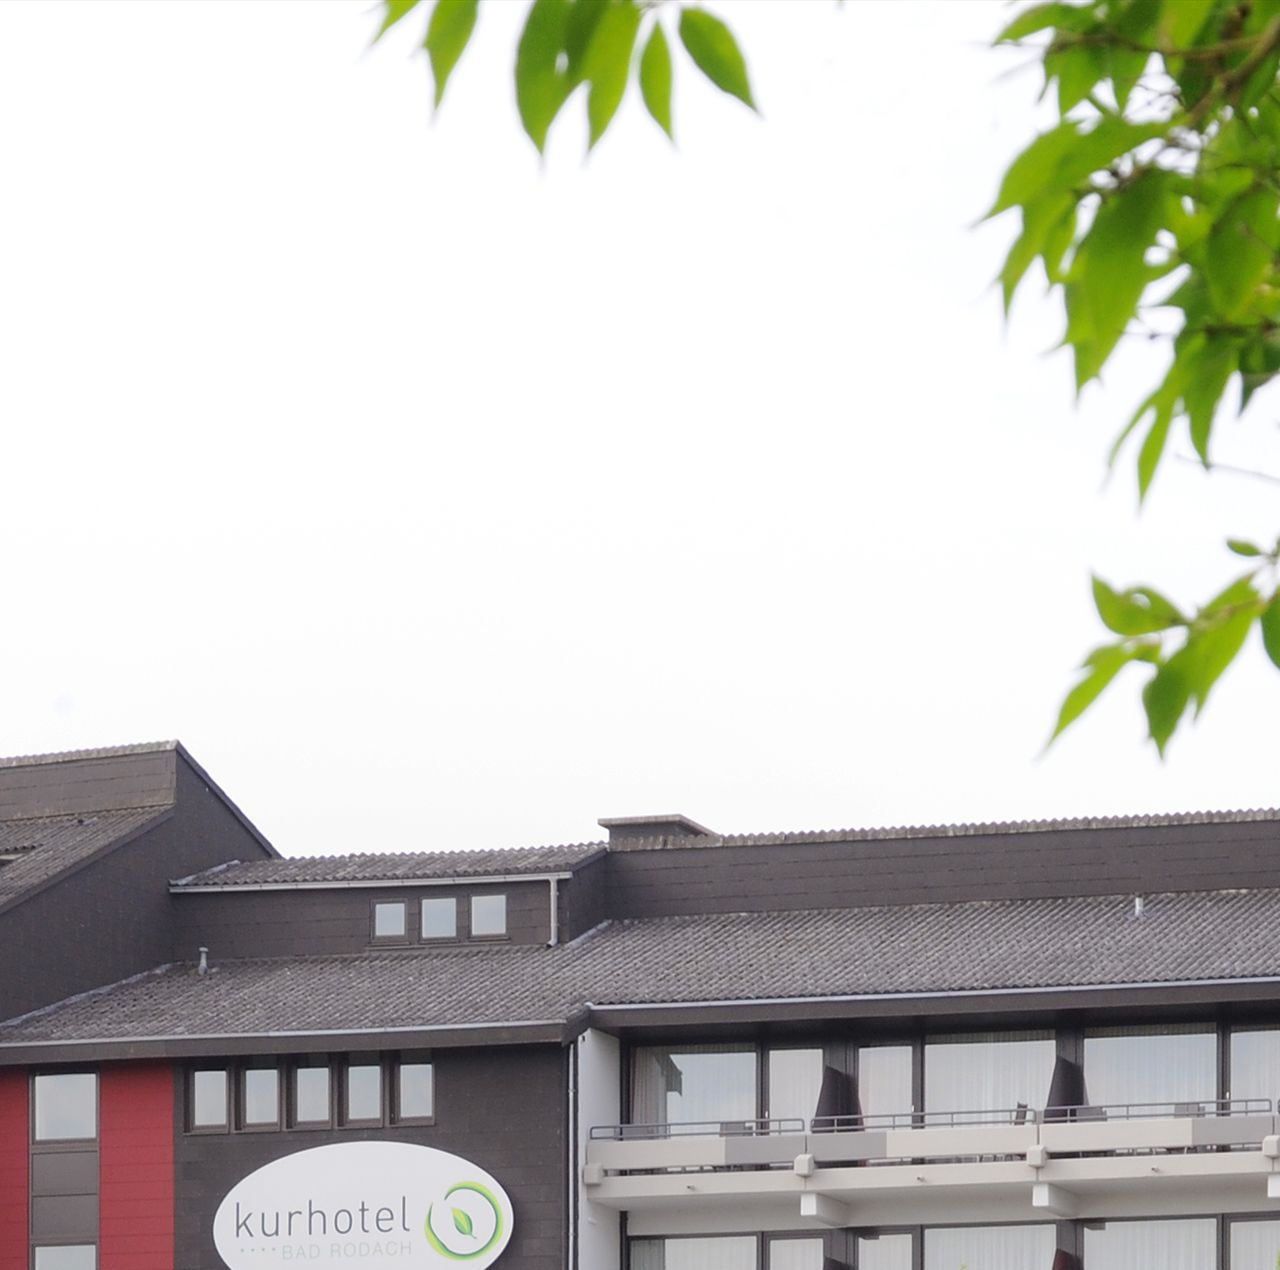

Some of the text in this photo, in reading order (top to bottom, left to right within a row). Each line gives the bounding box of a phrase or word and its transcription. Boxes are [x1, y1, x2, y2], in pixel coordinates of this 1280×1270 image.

[235, 1195, 411, 1239] kurhotel
[281, 1240, 412, 1261] BAD RODACH
